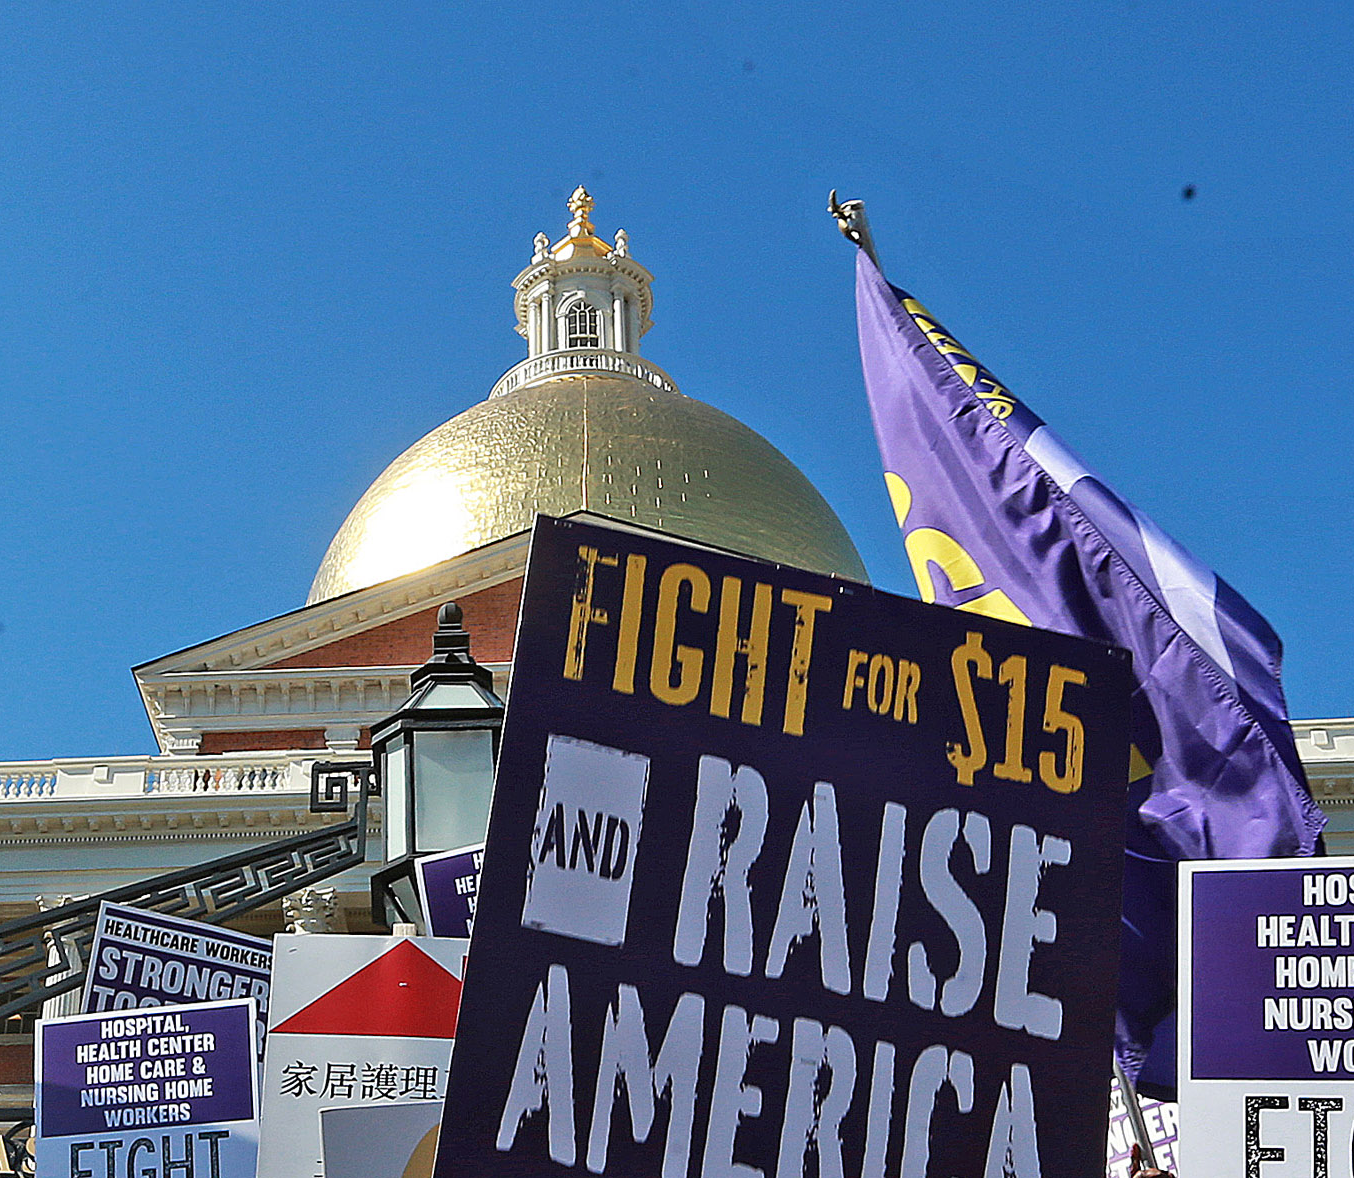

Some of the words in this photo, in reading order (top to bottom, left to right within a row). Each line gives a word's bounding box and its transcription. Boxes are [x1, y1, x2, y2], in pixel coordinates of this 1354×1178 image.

[564, 545, 833, 736] FIGHT
[843, 649, 922, 724] FOR
[946, 632, 1088, 794] $15
[538, 804, 630, 880] AND
[673, 754, 1072, 1039] RAISE
[104, 919, 199, 953] HEALTHCARE
[99, 946, 269, 1013] STRONGER
[101, 1015, 189, 1039] HOSPITAL,
[76, 1040, 141, 1063] HEALTH
[147, 1033, 215, 1055] CENTER
[86, 1062, 134, 1084] HOME
[140, 1058, 186, 1079] CARE
[192, 1057, 206, 1075] &
[280, 1060, 449, 1101] 家居護理
[80, 1084, 159, 1108] NURSING
[165, 1078, 213, 1099] HOME
[104, 1104, 191, 1128] WORKERS
